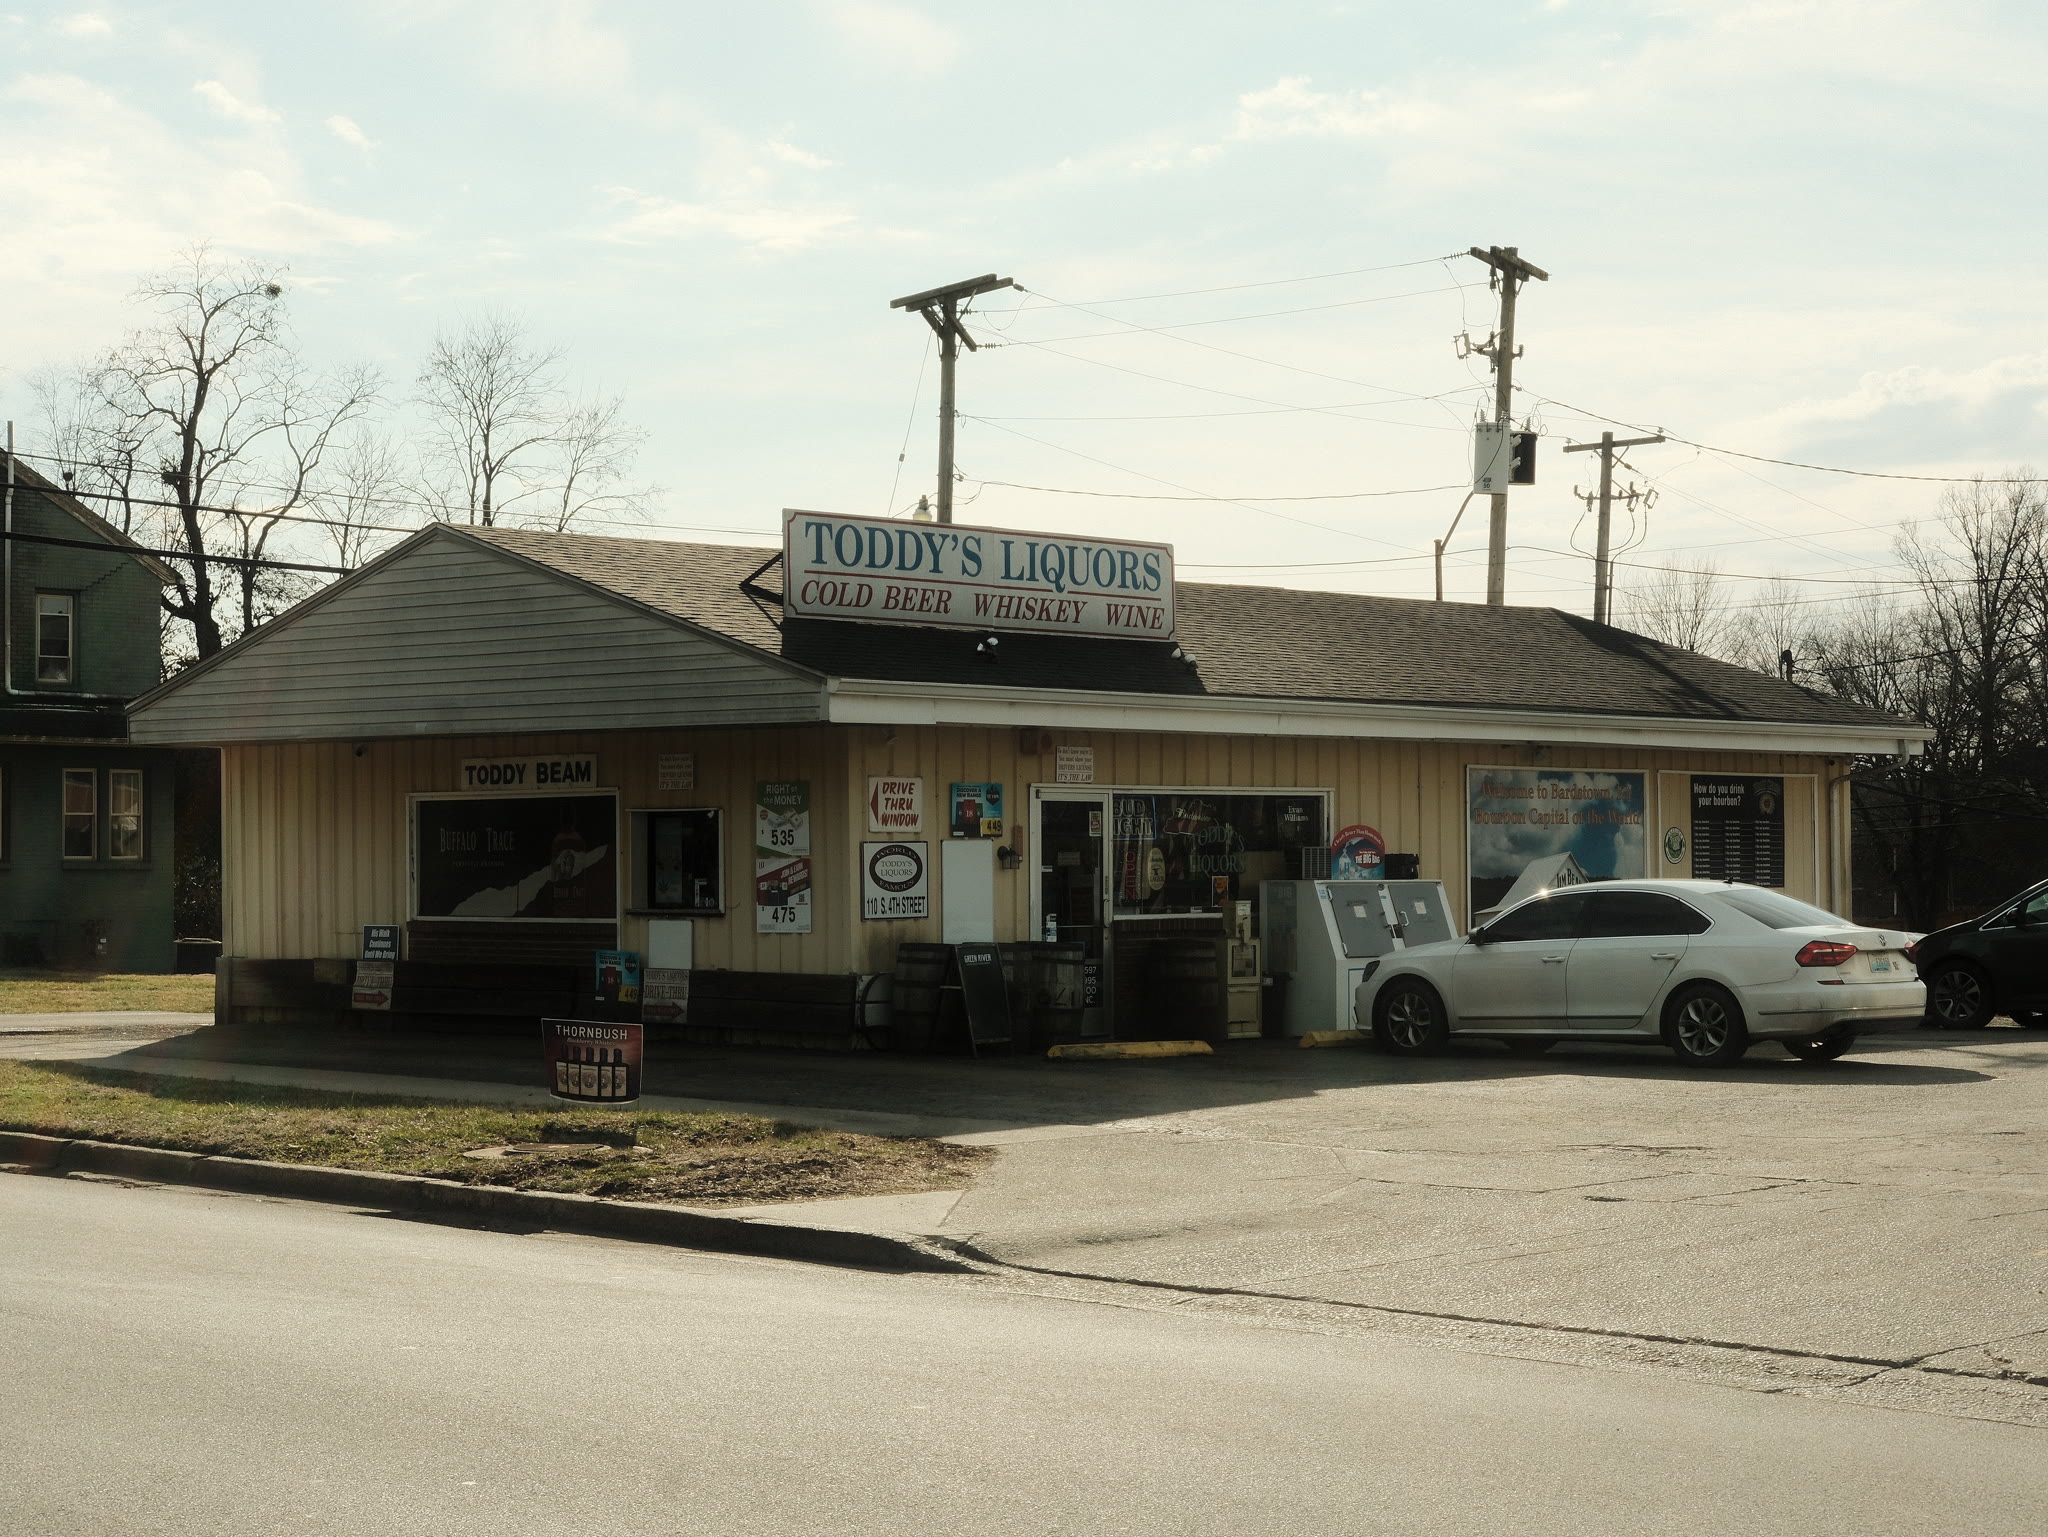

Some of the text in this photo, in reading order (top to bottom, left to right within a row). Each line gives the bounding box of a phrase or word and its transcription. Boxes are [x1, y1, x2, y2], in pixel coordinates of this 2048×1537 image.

[805, 521, 1161, 593] TODDY'S LIQUORS
[801, 580, 1165, 630] COLD BEER WHISKEY WINE
[465, 761, 591, 785] TODDY BEAM
[1069, 773, 1078, 781] THE
[766, 784, 790, 794] RIGHT
[882, 782, 915, 794] DRIVE
[1481, 783, 1534, 799] Welcome
[1537, 785, 1548, 799] to
[1693, 783, 1707, 794] How
[1708, 783, 1717, 794] do
[1718, 786, 1728, 796] you
[1729, 783, 1745, 794] drink
[774, 795, 802, 805] MONEY
[884, 797, 913, 811] THRU
[1698, 795, 1741, 808] your bourbon?
[965, 810, 974, 818] 18
[1113, 799, 1146, 817] BUD
[1288, 806, 1303, 814] Evan
[881, 813, 919, 827] WINDOW
[1284, 813, 1309, 822] Williams
[1474, 808, 1641, 830] Bourbon Capital of the World
[986, 820, 1002, 832] 449
[1113, 817, 1154, 836] IGHT
[771, 829, 794, 846] 535
[1191, 825, 1246, 852] TODDY'S
[876, 847, 917, 859] WORLD
[1363, 854, 1372, 864] BIG
[1372, 854, 1381, 864] BAG
[781, 869, 790, 879] JOIN
[794, 862, 804, 872] EARN
[880, 869, 913, 877] LIQUORS
[1188, 854, 1247, 880] LIQUORS
[1124, 850, 1137, 901] OPEN
[1556, 873, 1567, 888] JIM
[879, 880, 914, 891] FAMOUS
[867, 896, 926, 915] 110 S. 4TH STREET
[772, 907, 796, 923] 475
[371, 929, 390, 937] His Walk
[369, 940, 392, 949] Continues
[364, 950, 396, 959] Until We Bring
[964, 954, 993, 963] GREEN RIVER
[1084, 966, 1097, 974] 597
[624, 987, 638, 999] 449
[645, 985, 688, 1000] DRIVE-THRU
[555, 1025, 628, 1040] THORNBUSH
[567, 1037, 593, 1045] Blackberry
